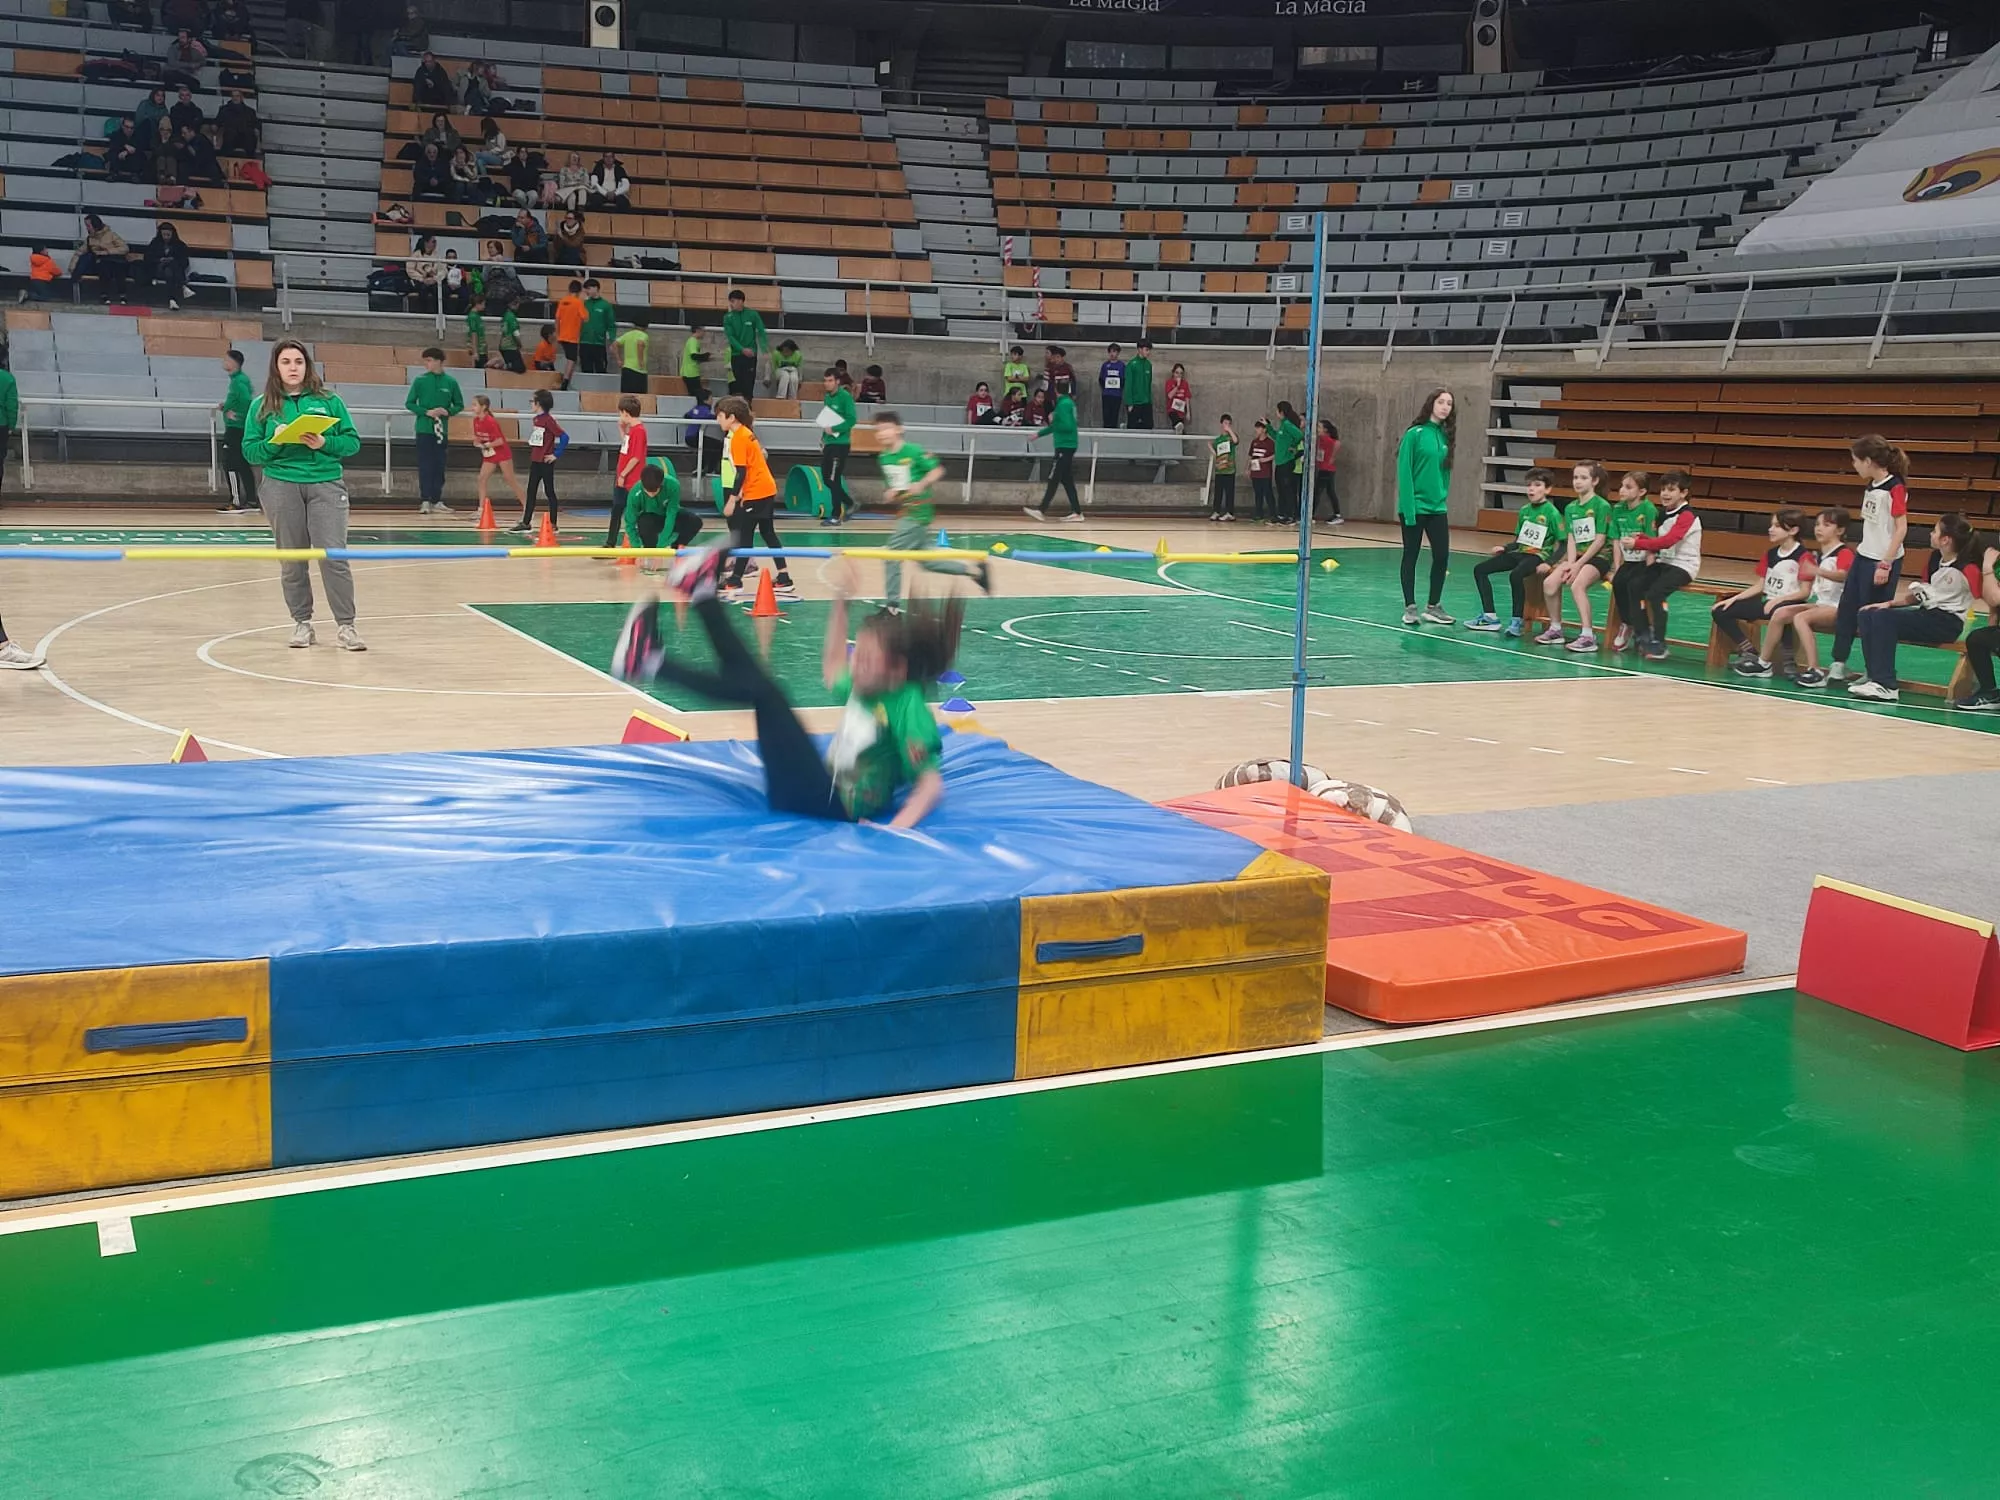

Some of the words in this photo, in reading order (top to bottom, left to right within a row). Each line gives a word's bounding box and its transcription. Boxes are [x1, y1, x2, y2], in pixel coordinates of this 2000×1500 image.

[1275, 1, 1298, 15] La
[1523, 528, 1541, 541] 493
[1767, 576, 1785, 590] 475
